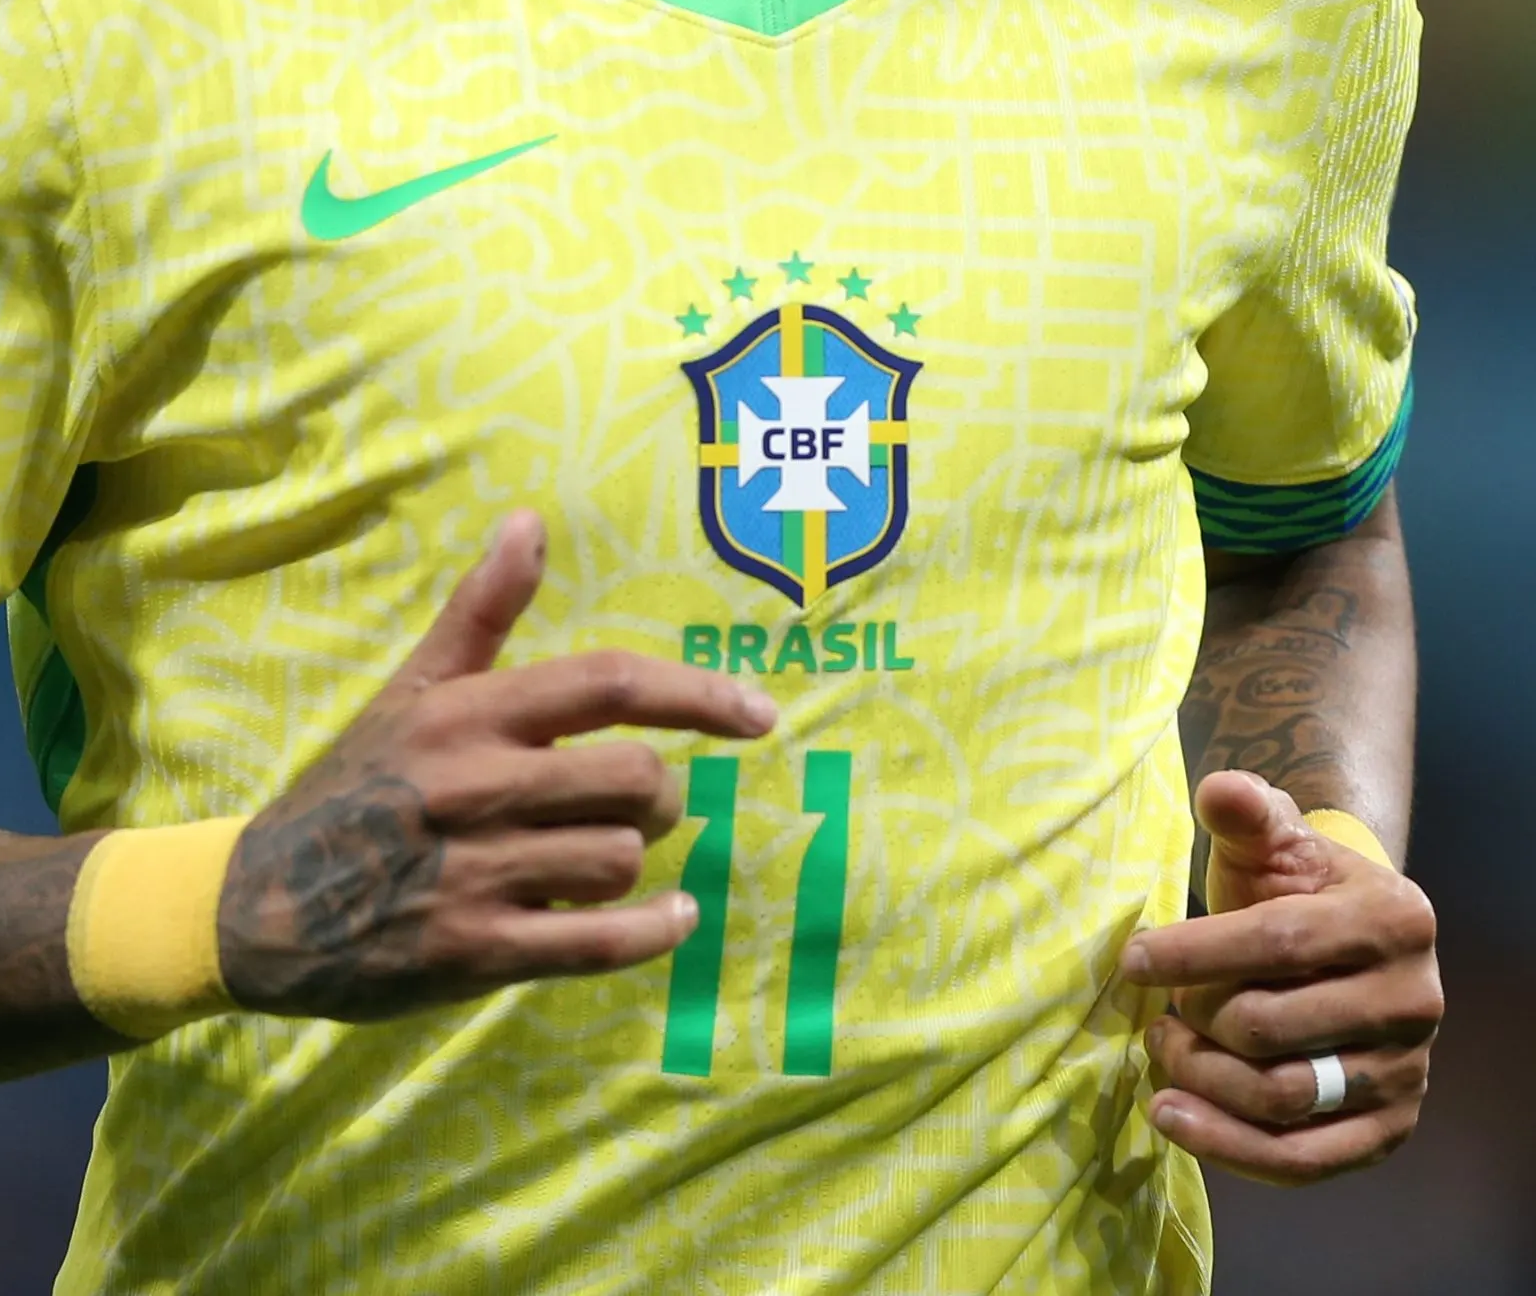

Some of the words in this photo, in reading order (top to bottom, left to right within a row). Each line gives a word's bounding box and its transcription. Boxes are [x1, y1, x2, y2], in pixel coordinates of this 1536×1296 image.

[762, 427, 845, 461] CBF
[680, 621, 915, 674] BRASIL
[661, 749, 852, 1077] 11
